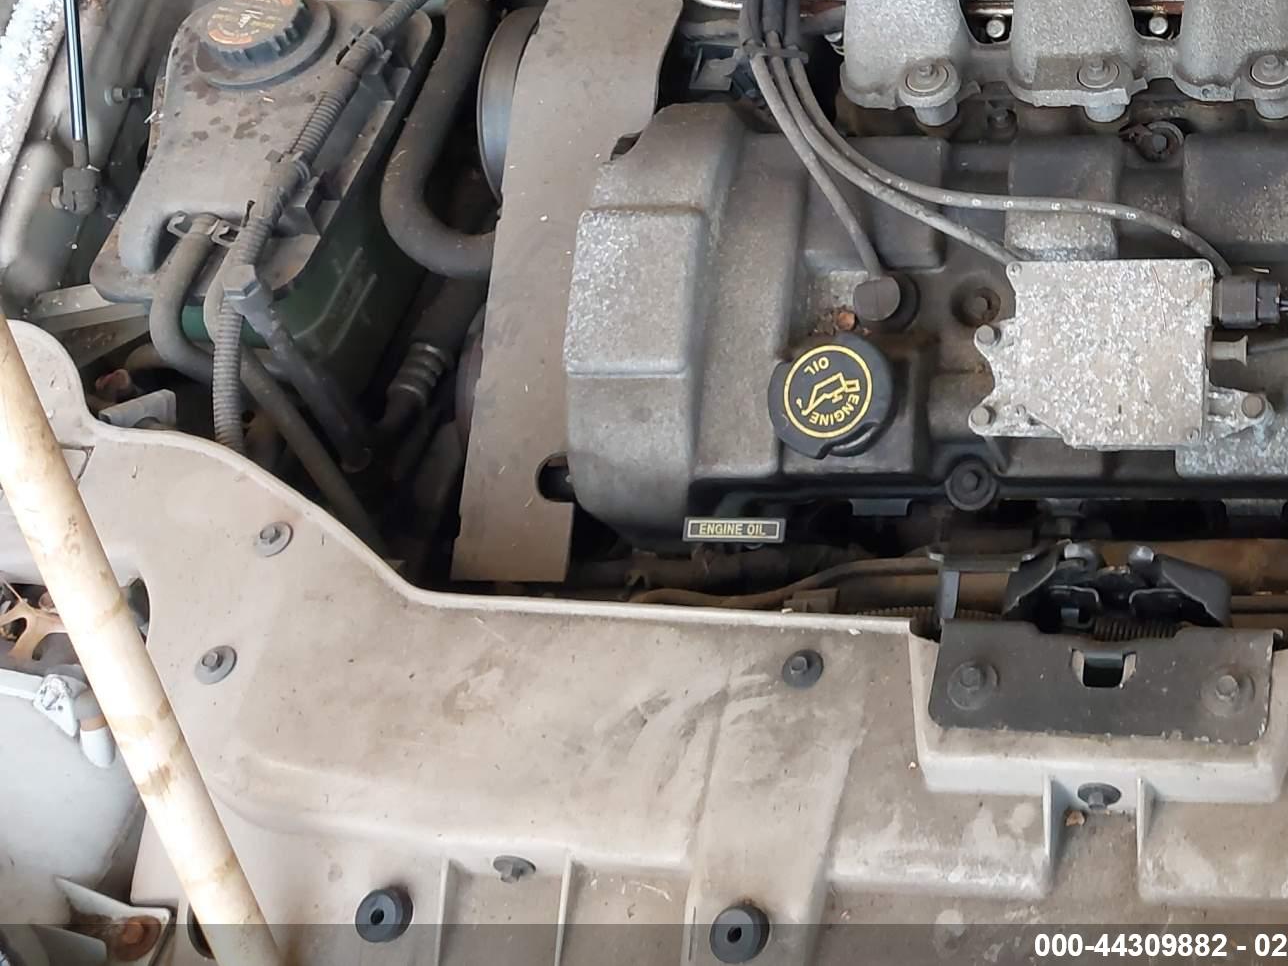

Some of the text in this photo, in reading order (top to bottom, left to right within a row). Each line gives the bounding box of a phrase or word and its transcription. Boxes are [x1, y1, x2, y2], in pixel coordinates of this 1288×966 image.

[804, 356, 830, 376] OIL
[809, 395, 860, 427] ENGINE
[699, 523, 766, 536] ENGINE OIL
